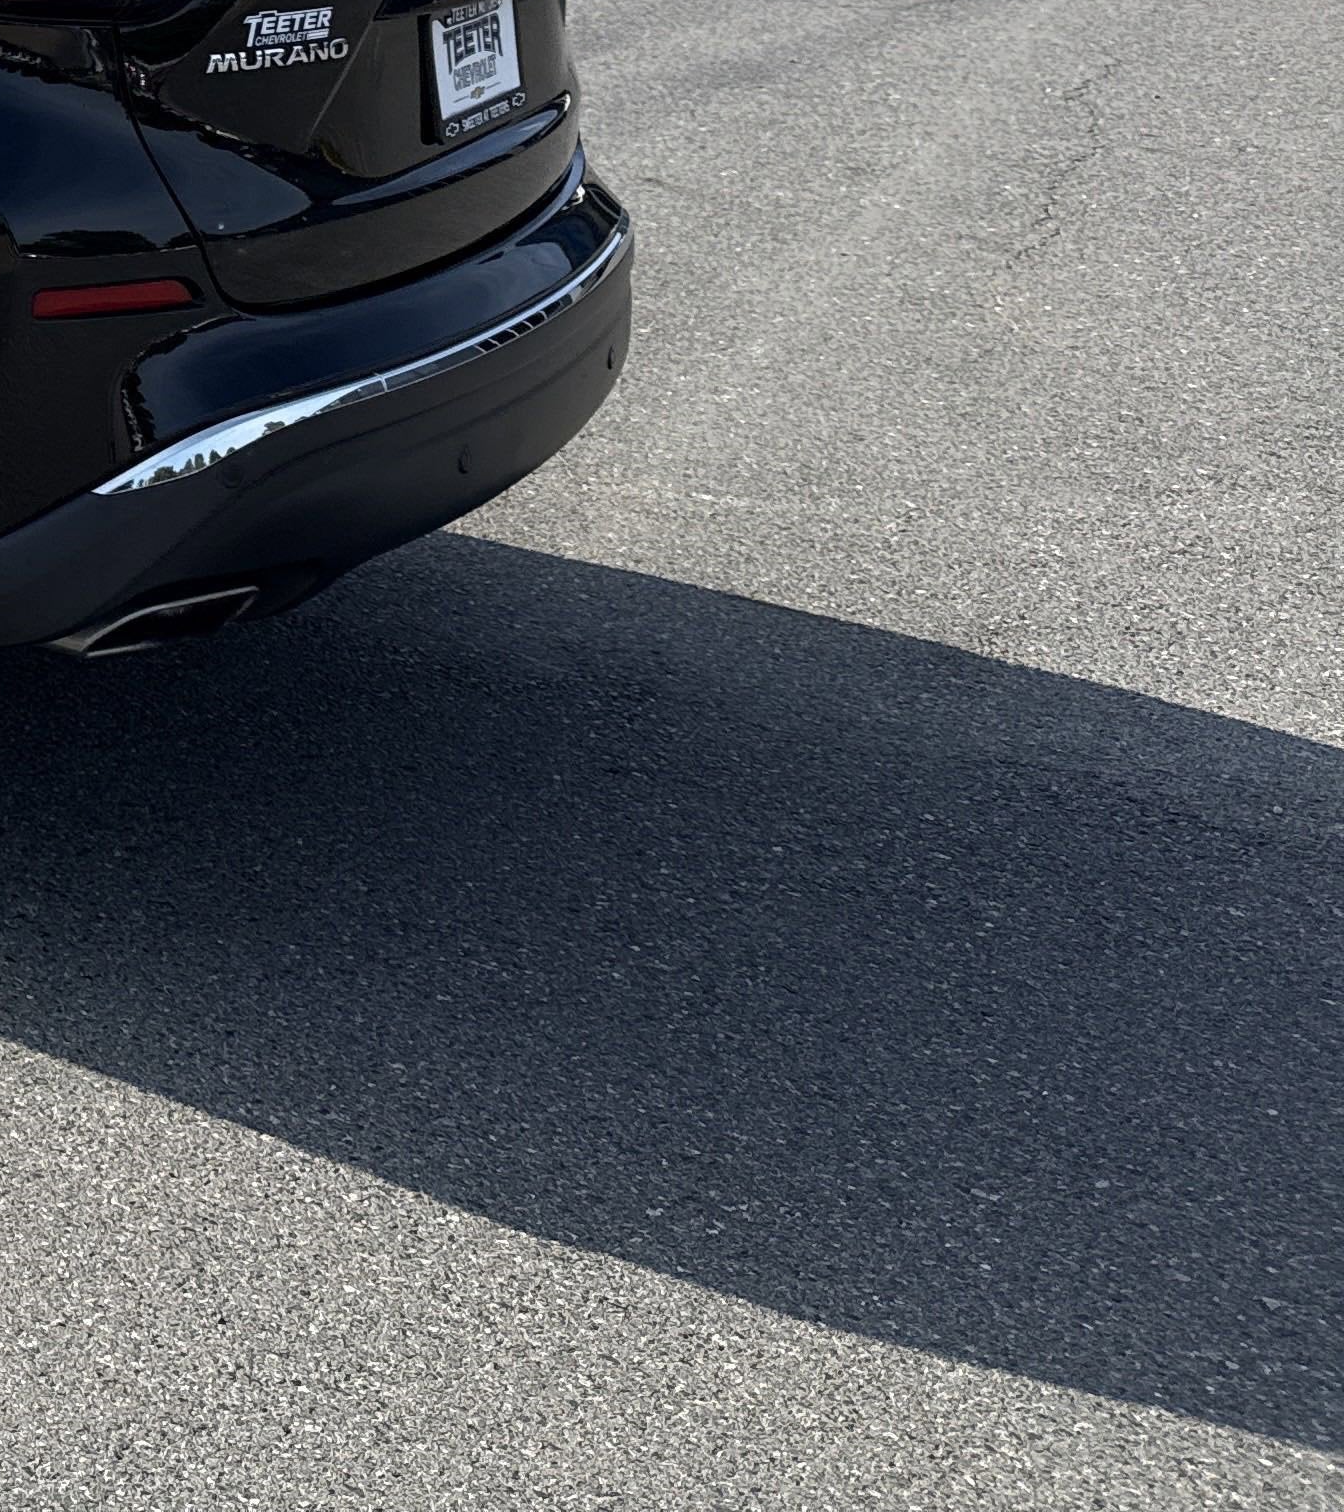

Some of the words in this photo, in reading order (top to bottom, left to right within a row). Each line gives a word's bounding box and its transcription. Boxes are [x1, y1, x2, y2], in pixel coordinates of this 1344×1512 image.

[243, 6, 333, 47] TEETER
[254, 31, 308, 47] CHEVROLET
[442, 12, 503, 75] TEETER
[205, 38, 349, 74] MURANO
